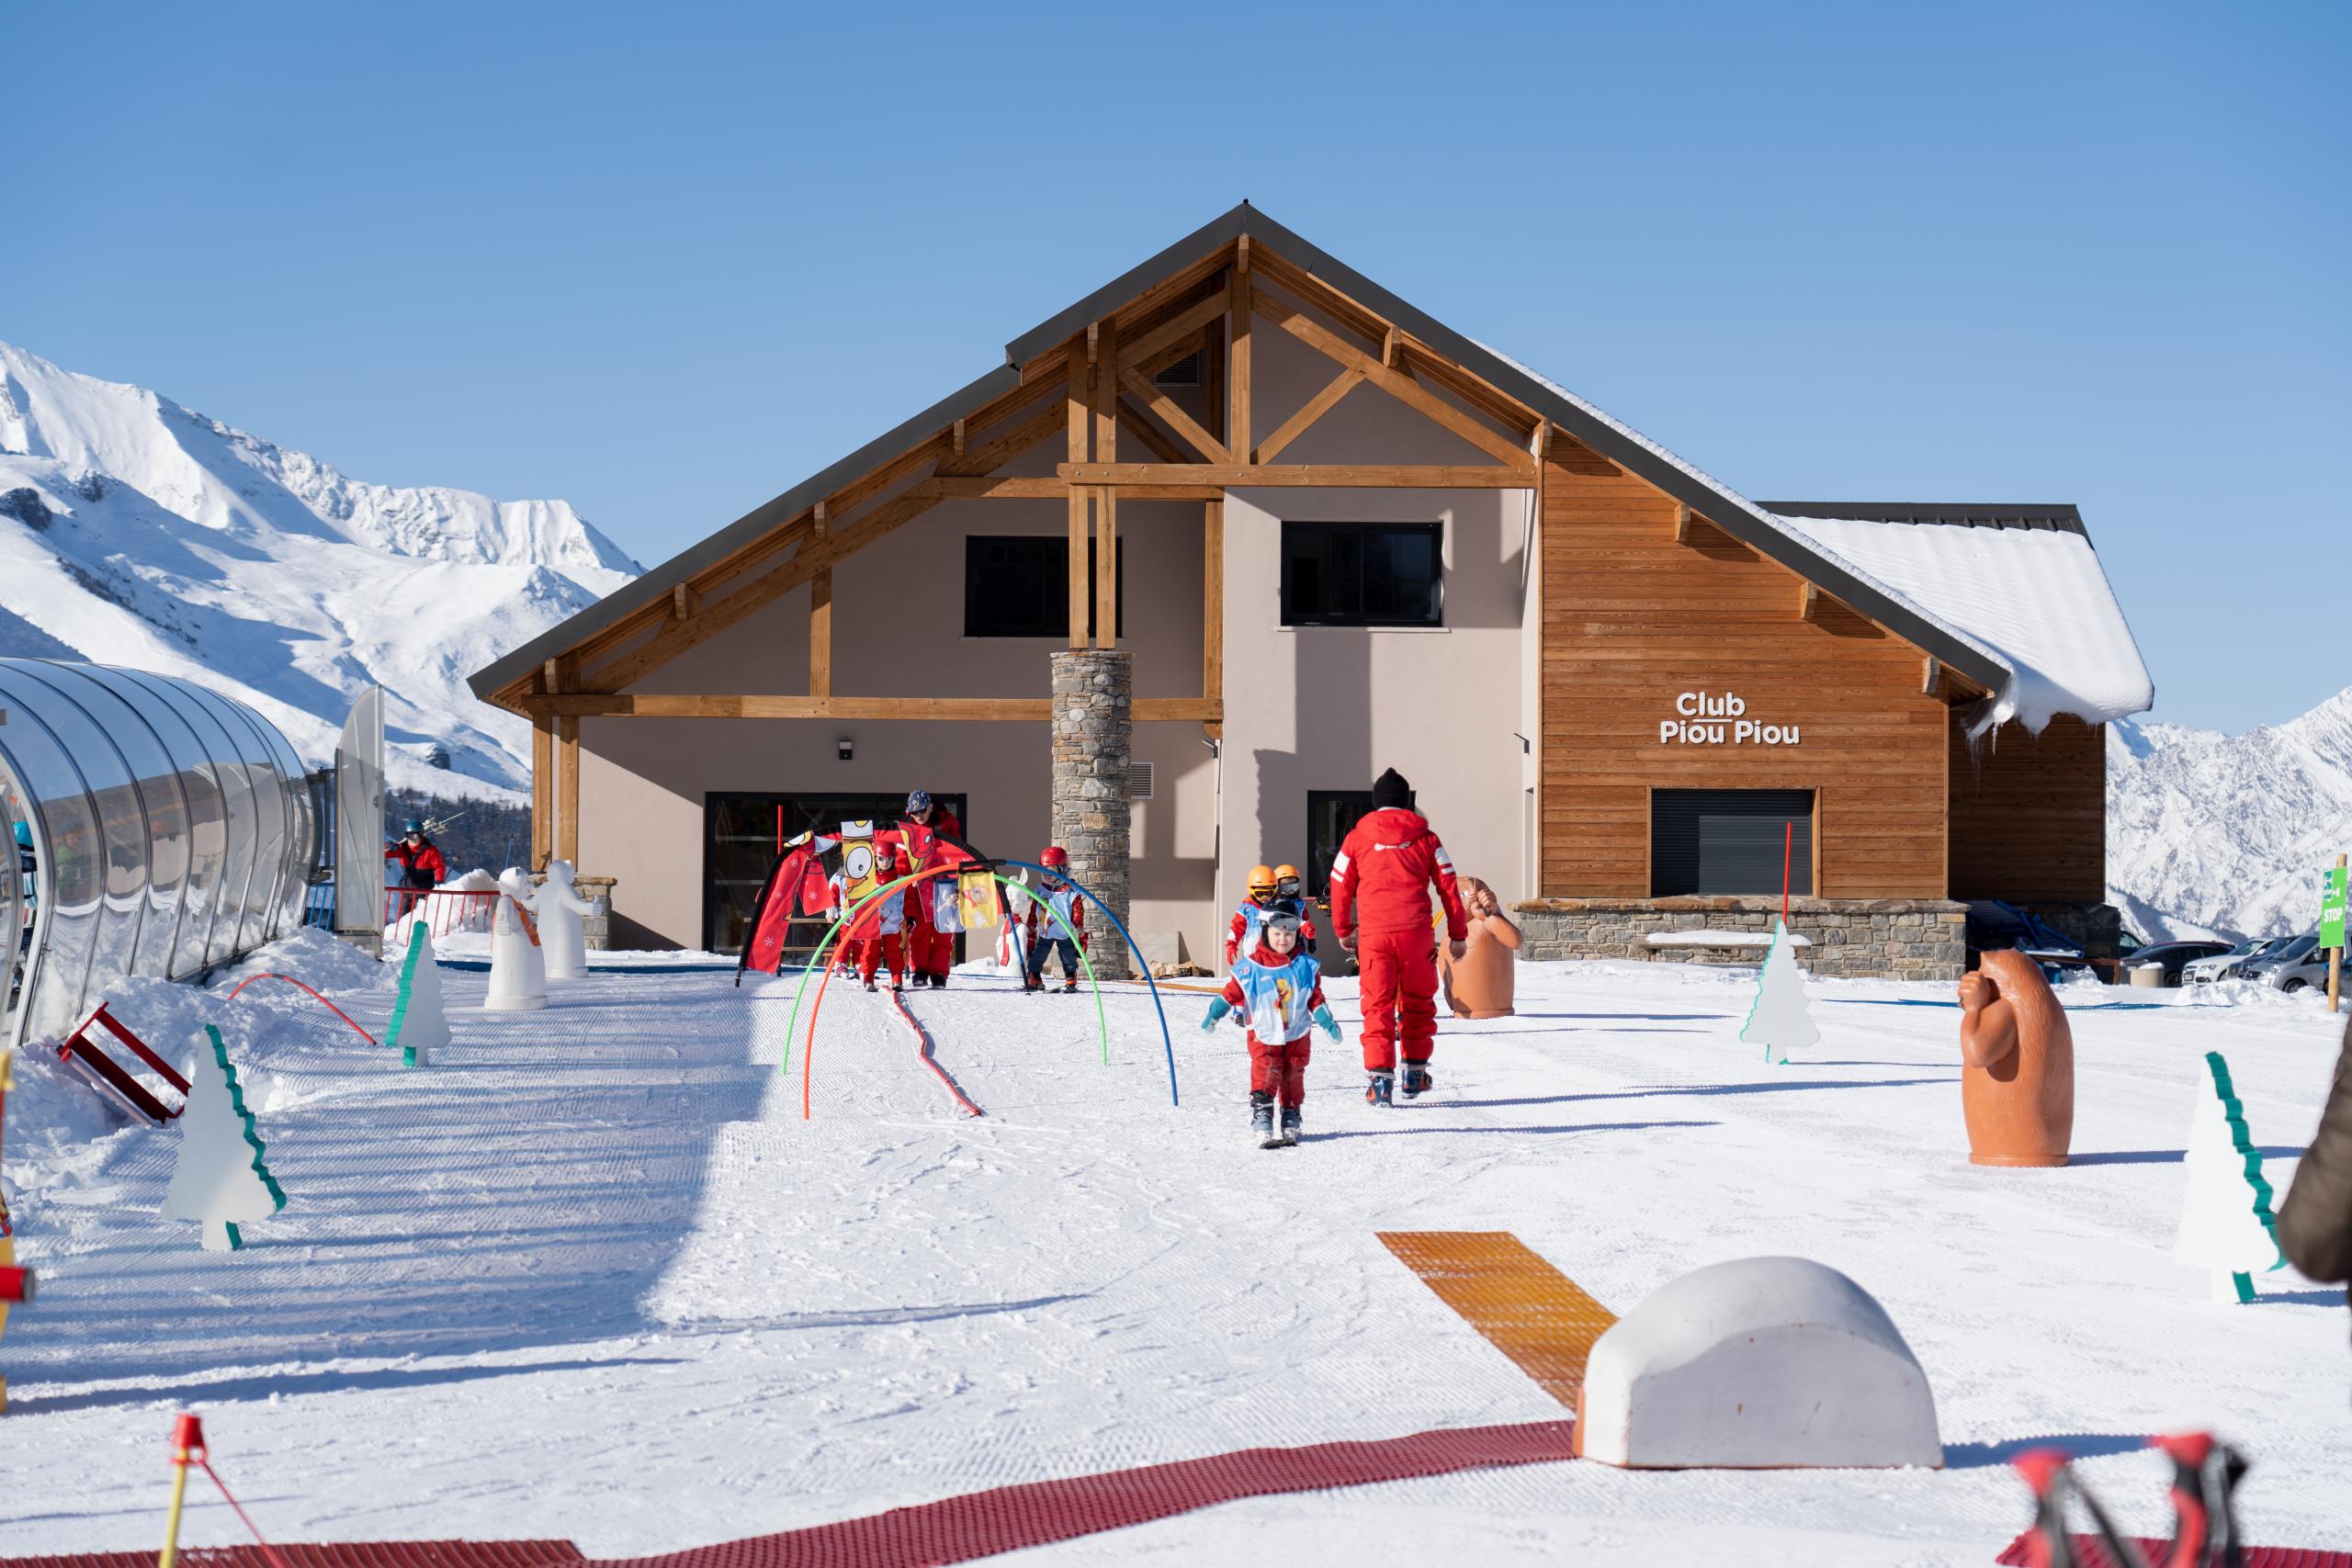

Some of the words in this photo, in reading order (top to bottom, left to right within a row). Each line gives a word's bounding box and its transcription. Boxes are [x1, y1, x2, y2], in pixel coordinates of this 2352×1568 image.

[1676, 691, 1746, 716] Club
[1660, 719, 1724, 744] Piou
[1735, 719, 1800, 744] Piou
[2324, 908, 2343, 922] STOP
